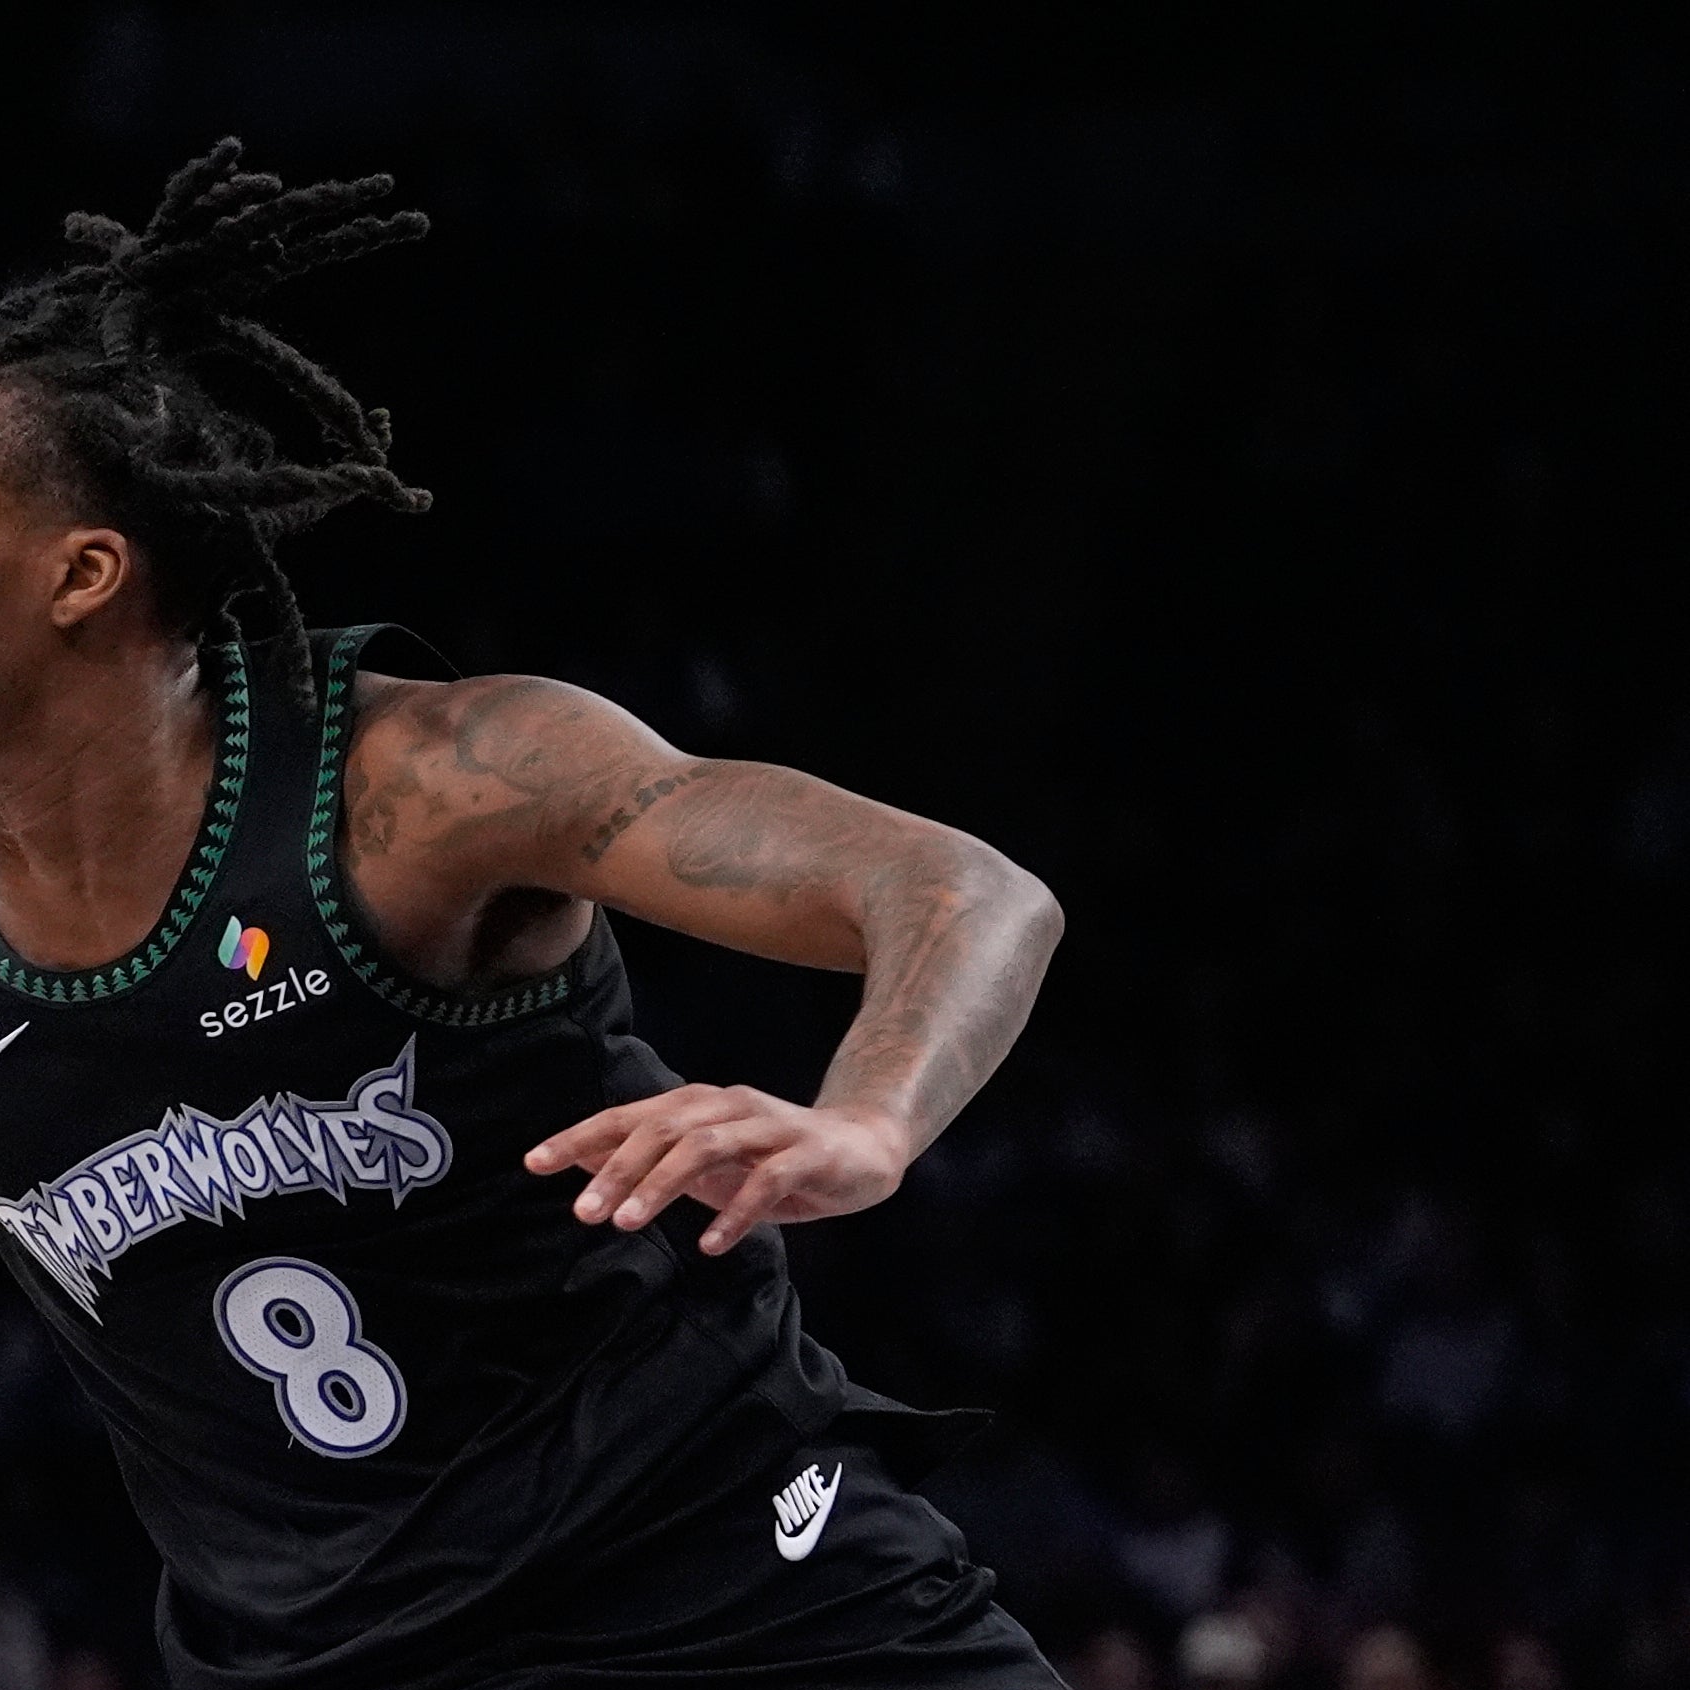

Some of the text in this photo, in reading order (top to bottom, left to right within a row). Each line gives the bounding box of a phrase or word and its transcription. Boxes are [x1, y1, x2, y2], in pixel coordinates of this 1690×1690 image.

[200, 963, 331, 1038] sezzle
[213, 1256, 408, 1459] 8
[772, 1464, 828, 1534] NIKE
